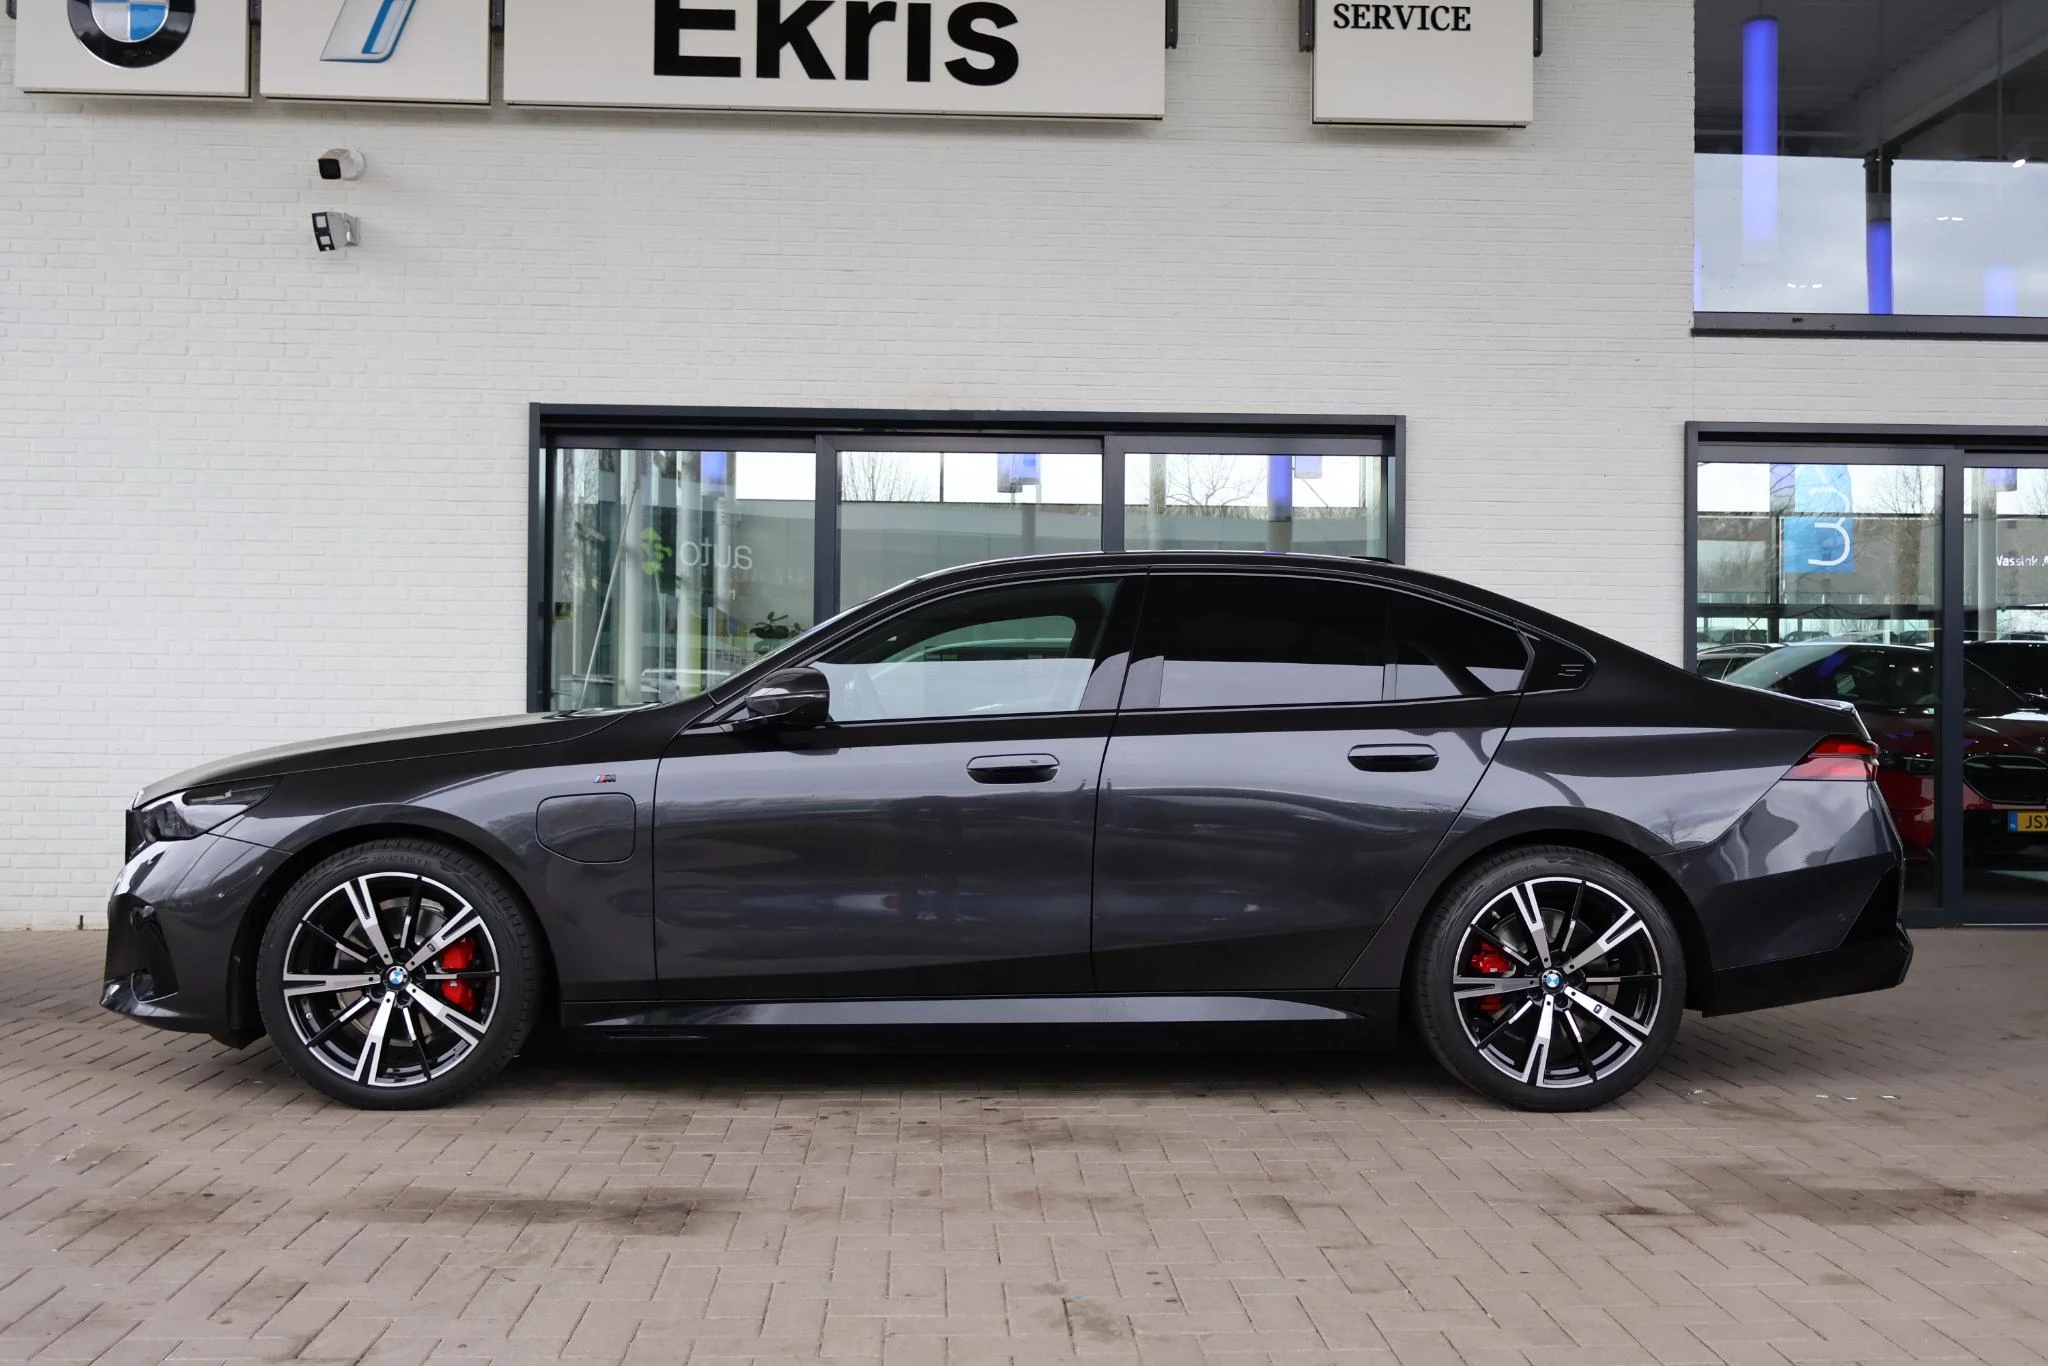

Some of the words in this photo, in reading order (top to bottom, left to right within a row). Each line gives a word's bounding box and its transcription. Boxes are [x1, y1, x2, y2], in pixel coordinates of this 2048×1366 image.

[1333, 3, 1471, 31] SERVICE
[654, 0, 1019, 86] Ekris
[1996, 555, 2038, 566] Vassink
